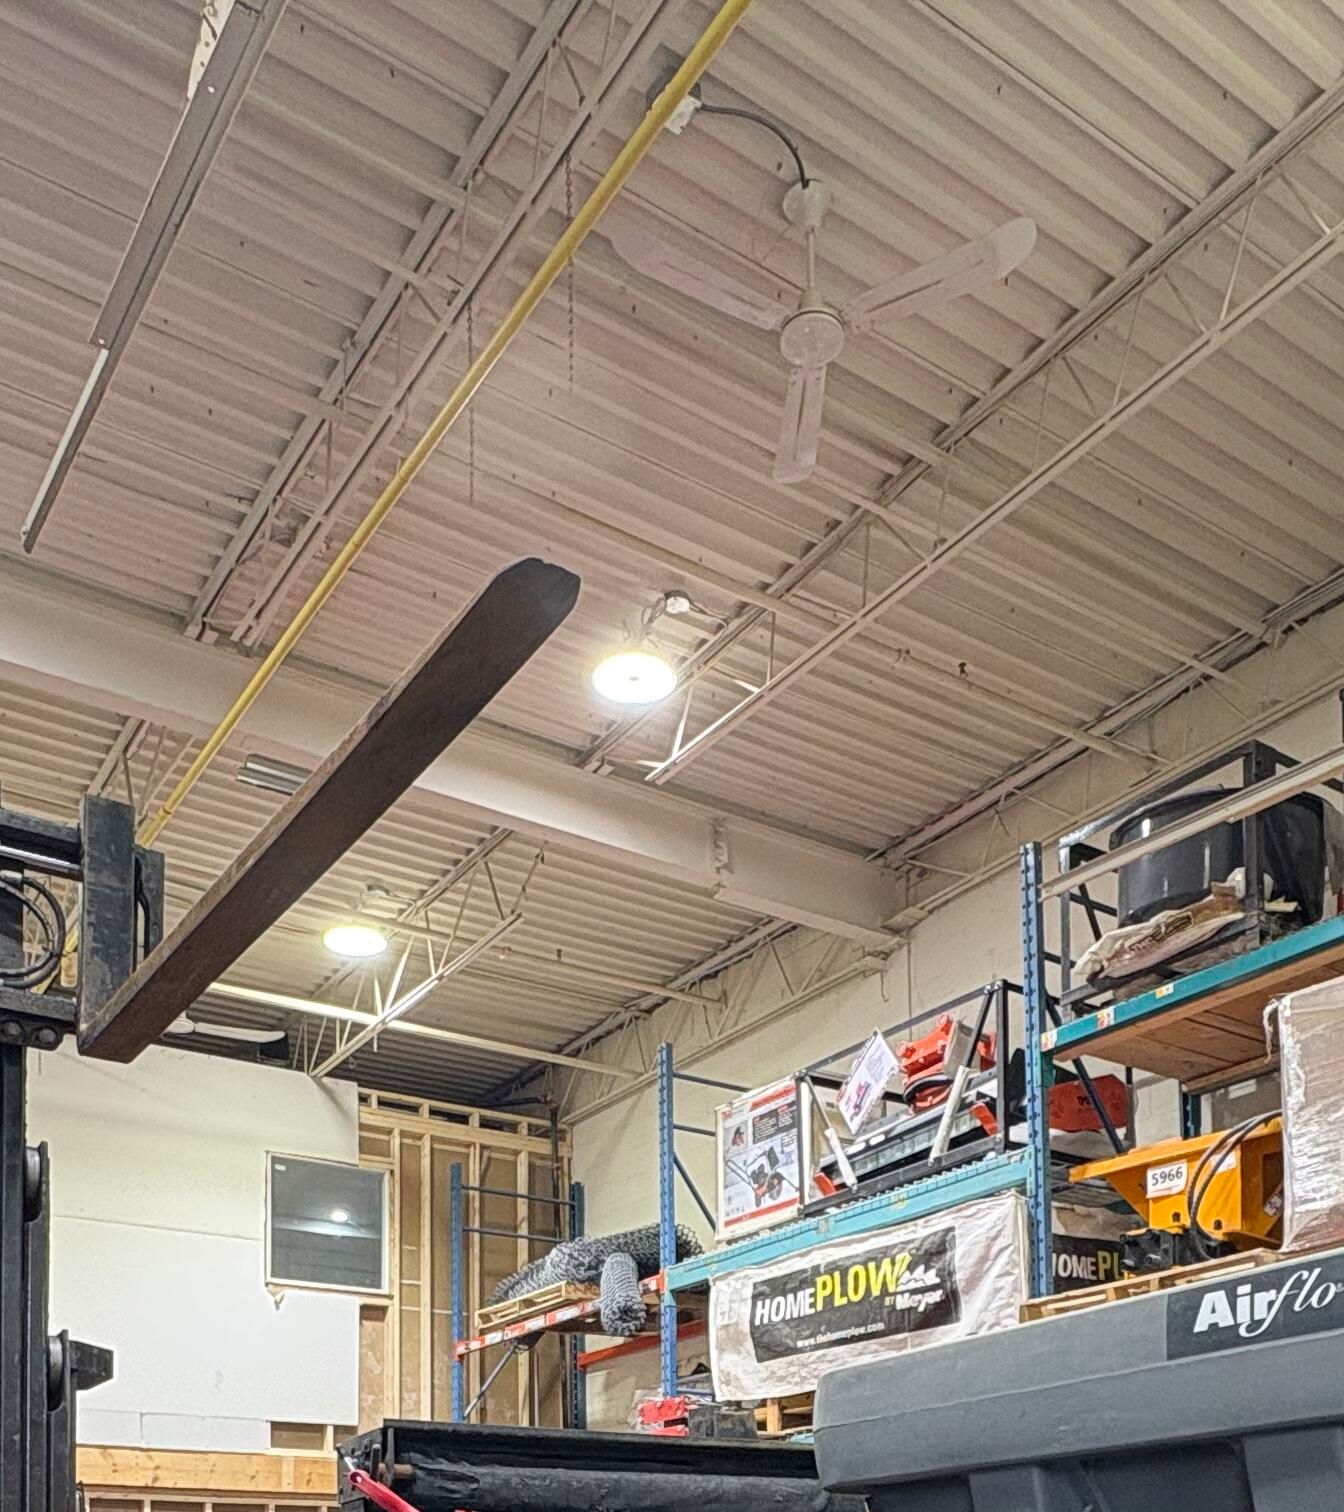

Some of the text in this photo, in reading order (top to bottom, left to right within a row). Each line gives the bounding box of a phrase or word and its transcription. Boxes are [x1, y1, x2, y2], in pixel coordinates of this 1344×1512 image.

[1151, 1166, 1184, 1187] 5966
[754, 1251, 913, 1326] HOMEPLOW
[1193, 1267, 1338, 1338] Airflo
